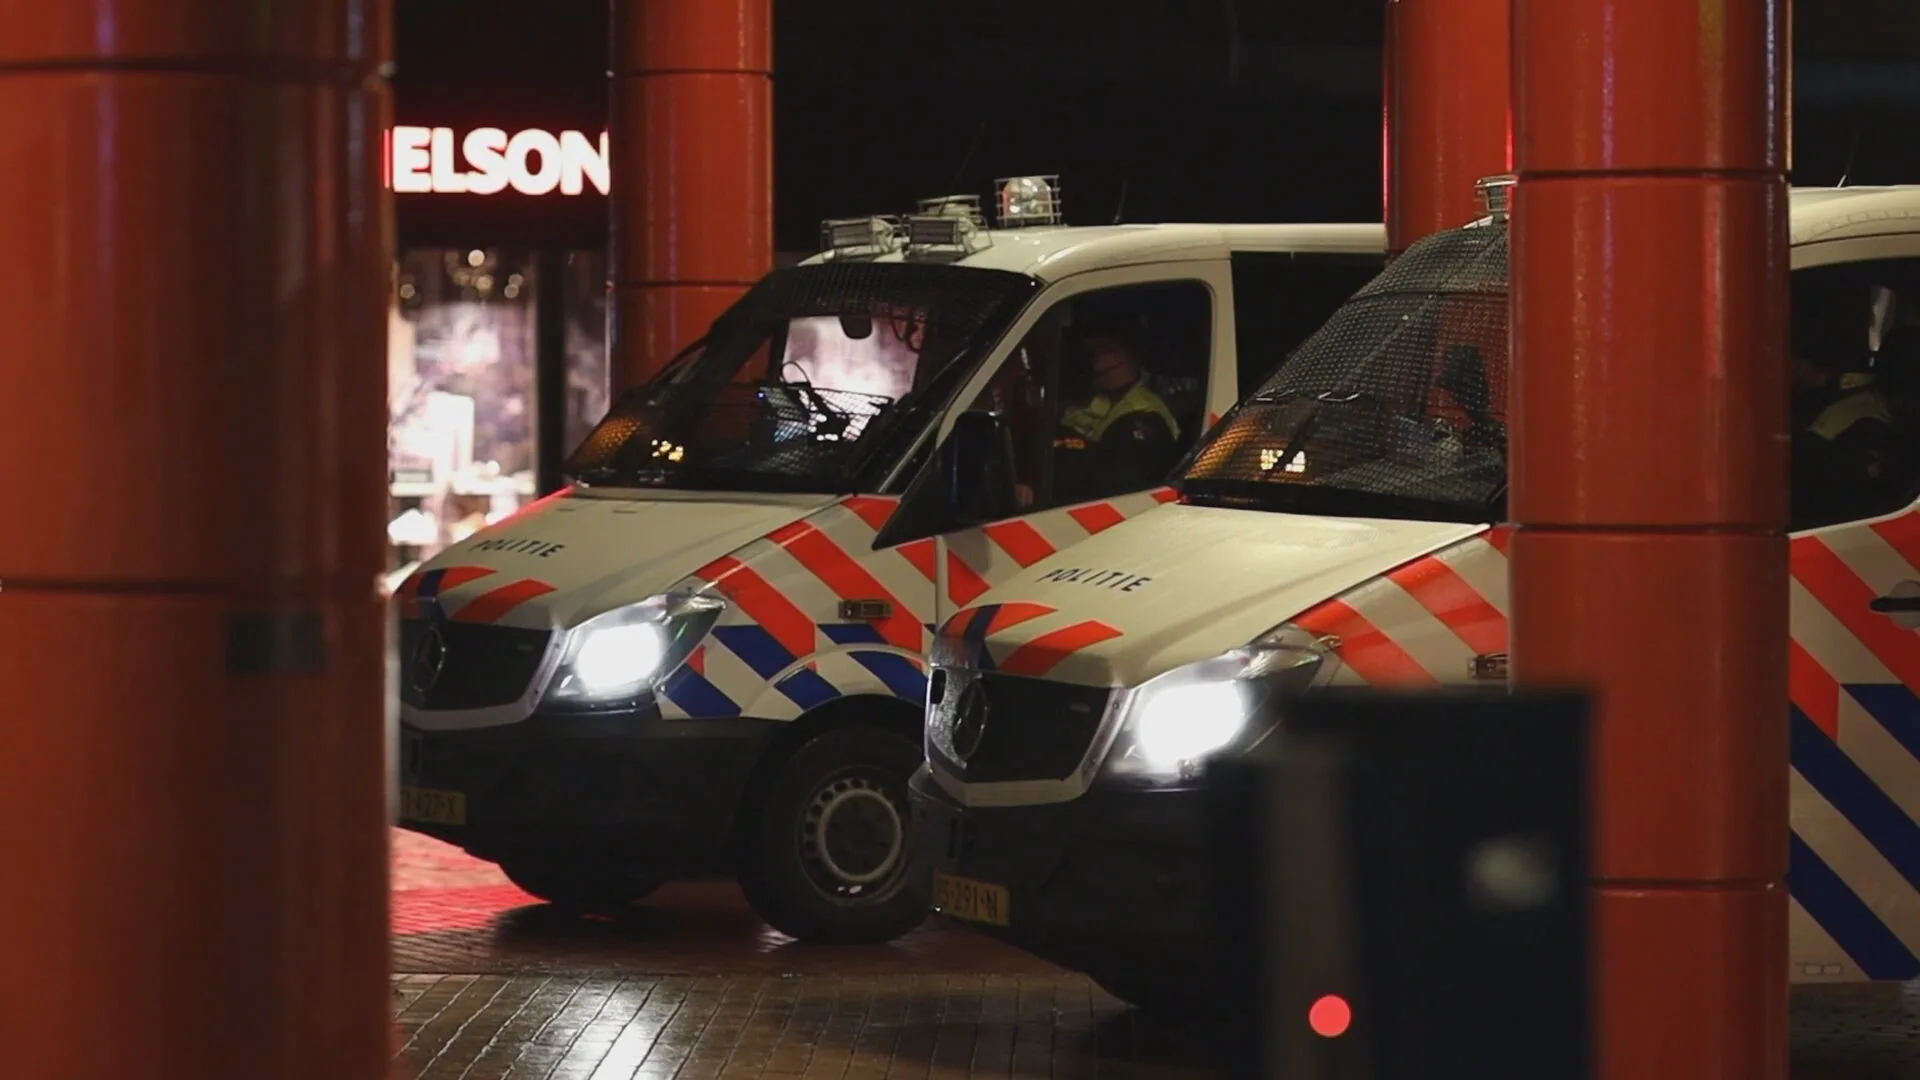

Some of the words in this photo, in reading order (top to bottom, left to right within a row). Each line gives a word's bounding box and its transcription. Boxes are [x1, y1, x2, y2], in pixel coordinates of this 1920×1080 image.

[384, 126, 611, 196] ELSON
[468, 539, 565, 557] POLITIE
[1035, 568, 1151, 592] POLITIE
